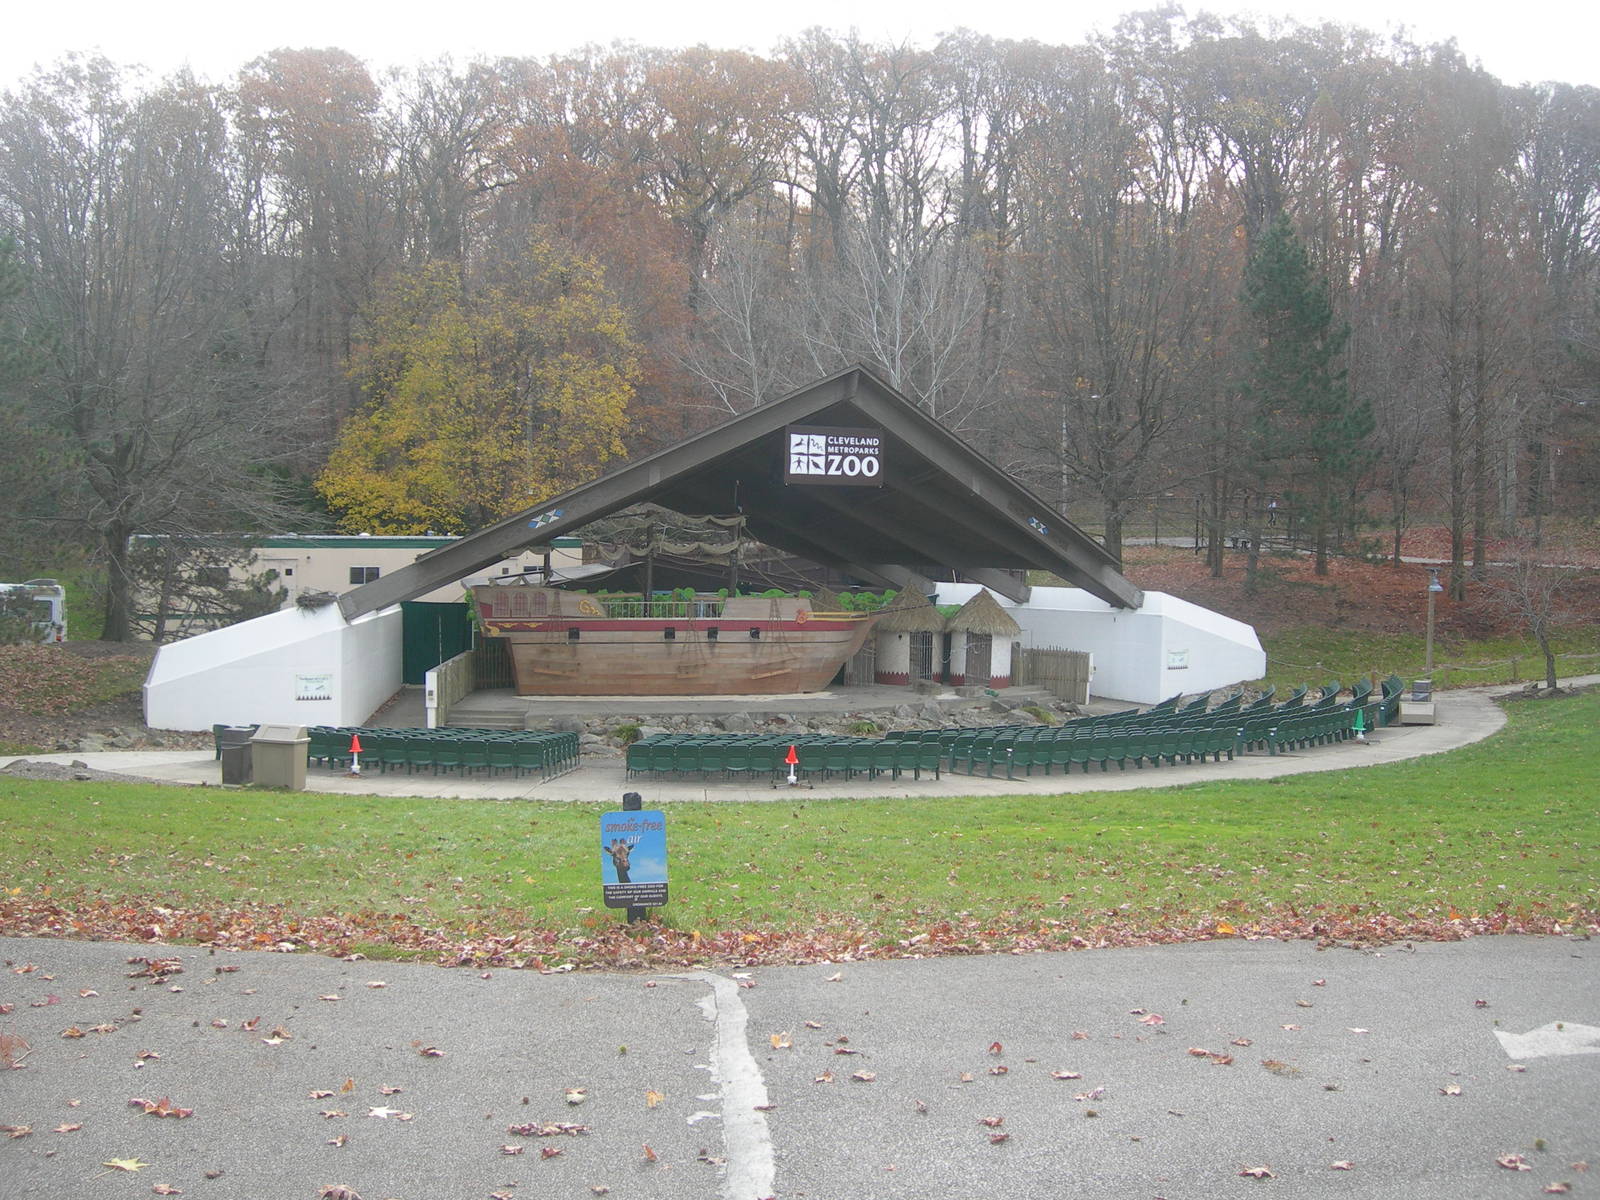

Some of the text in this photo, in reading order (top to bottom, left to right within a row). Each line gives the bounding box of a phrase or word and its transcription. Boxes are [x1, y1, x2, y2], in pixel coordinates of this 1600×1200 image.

[827, 436, 879, 446] CLEVELAND
[827, 446, 879, 455] METROPARKS
[827, 455, 879, 477] ZOO
[606, 820, 663, 833] smoke-free
[626, 834, 642, 844] air
